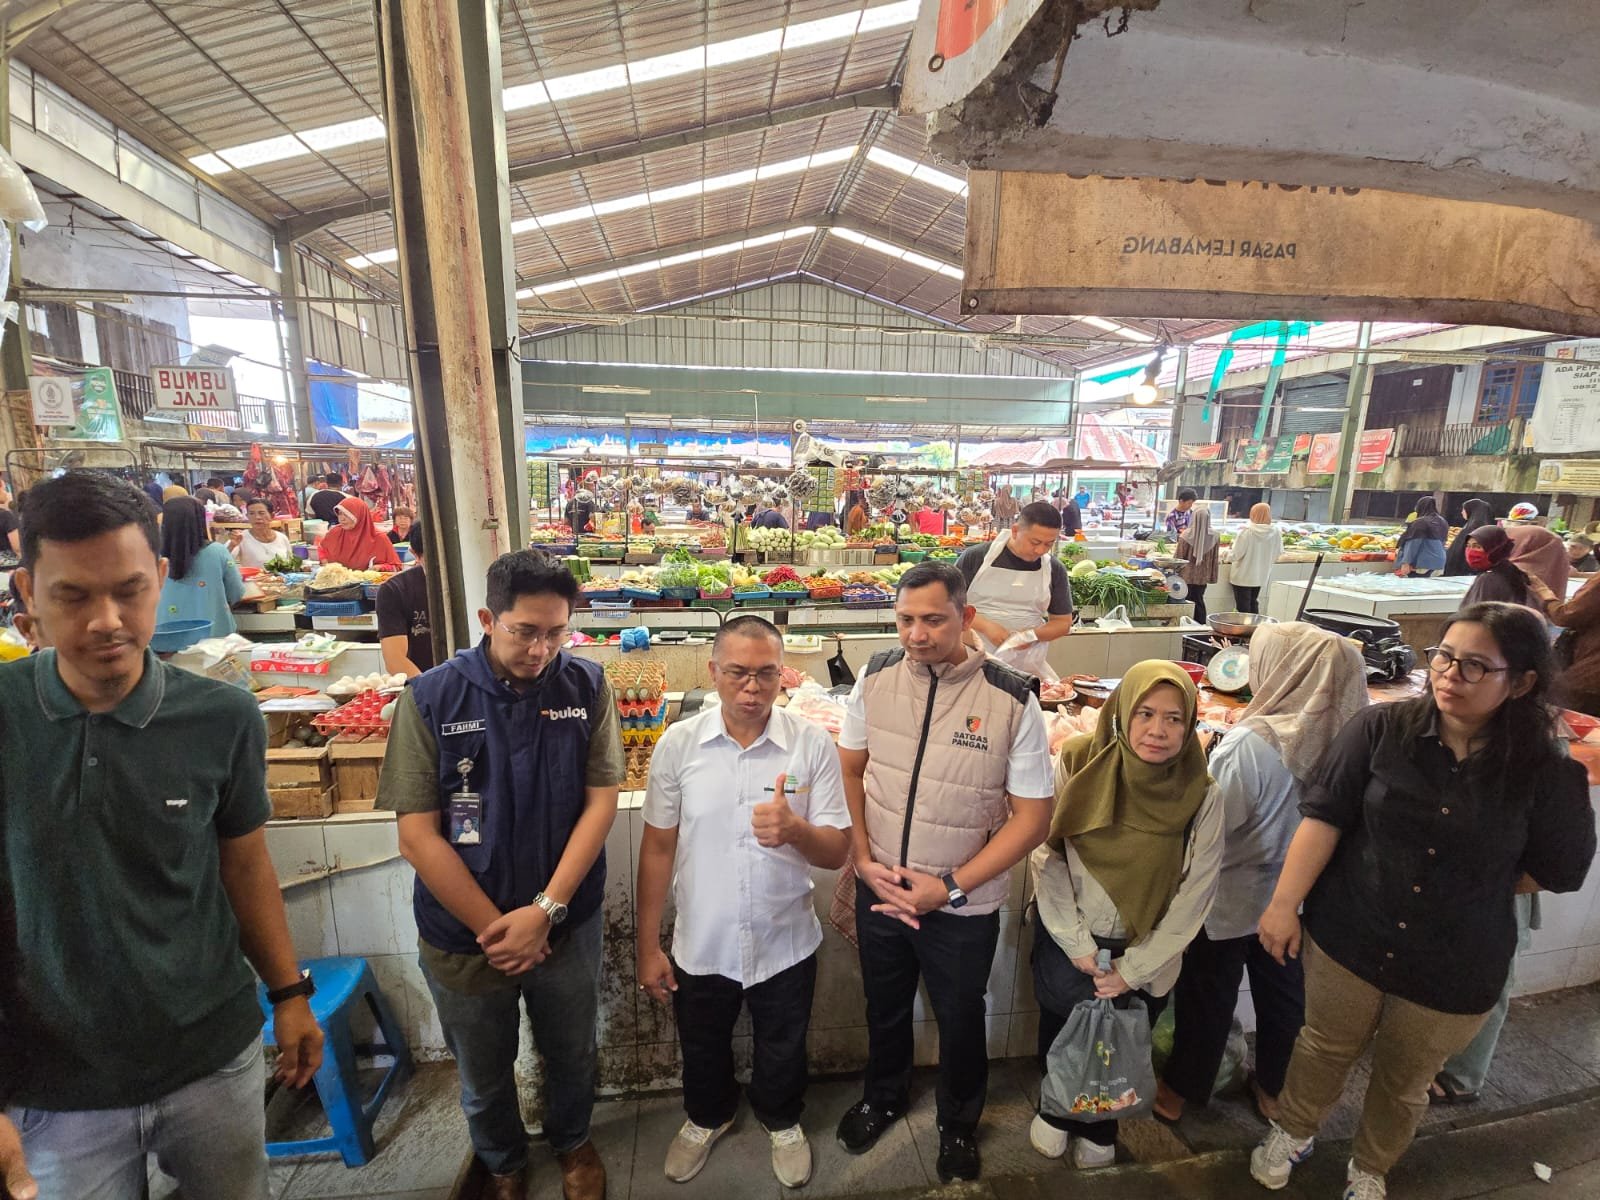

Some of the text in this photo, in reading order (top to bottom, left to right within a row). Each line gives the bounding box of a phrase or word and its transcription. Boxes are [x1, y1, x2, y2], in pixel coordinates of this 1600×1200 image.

[1555, 365, 1574, 373] ADA
[1573, 371, 1597, 379] SIAP
[159, 371, 227, 389] BUMBU
[173, 391, 219, 406] JAJA
[550, 706, 588, 720] bulog
[450, 721, 480, 732] FAHMI
[953, 731, 988, 743] SATGAS
[951, 738, 988, 751] PANGAN
